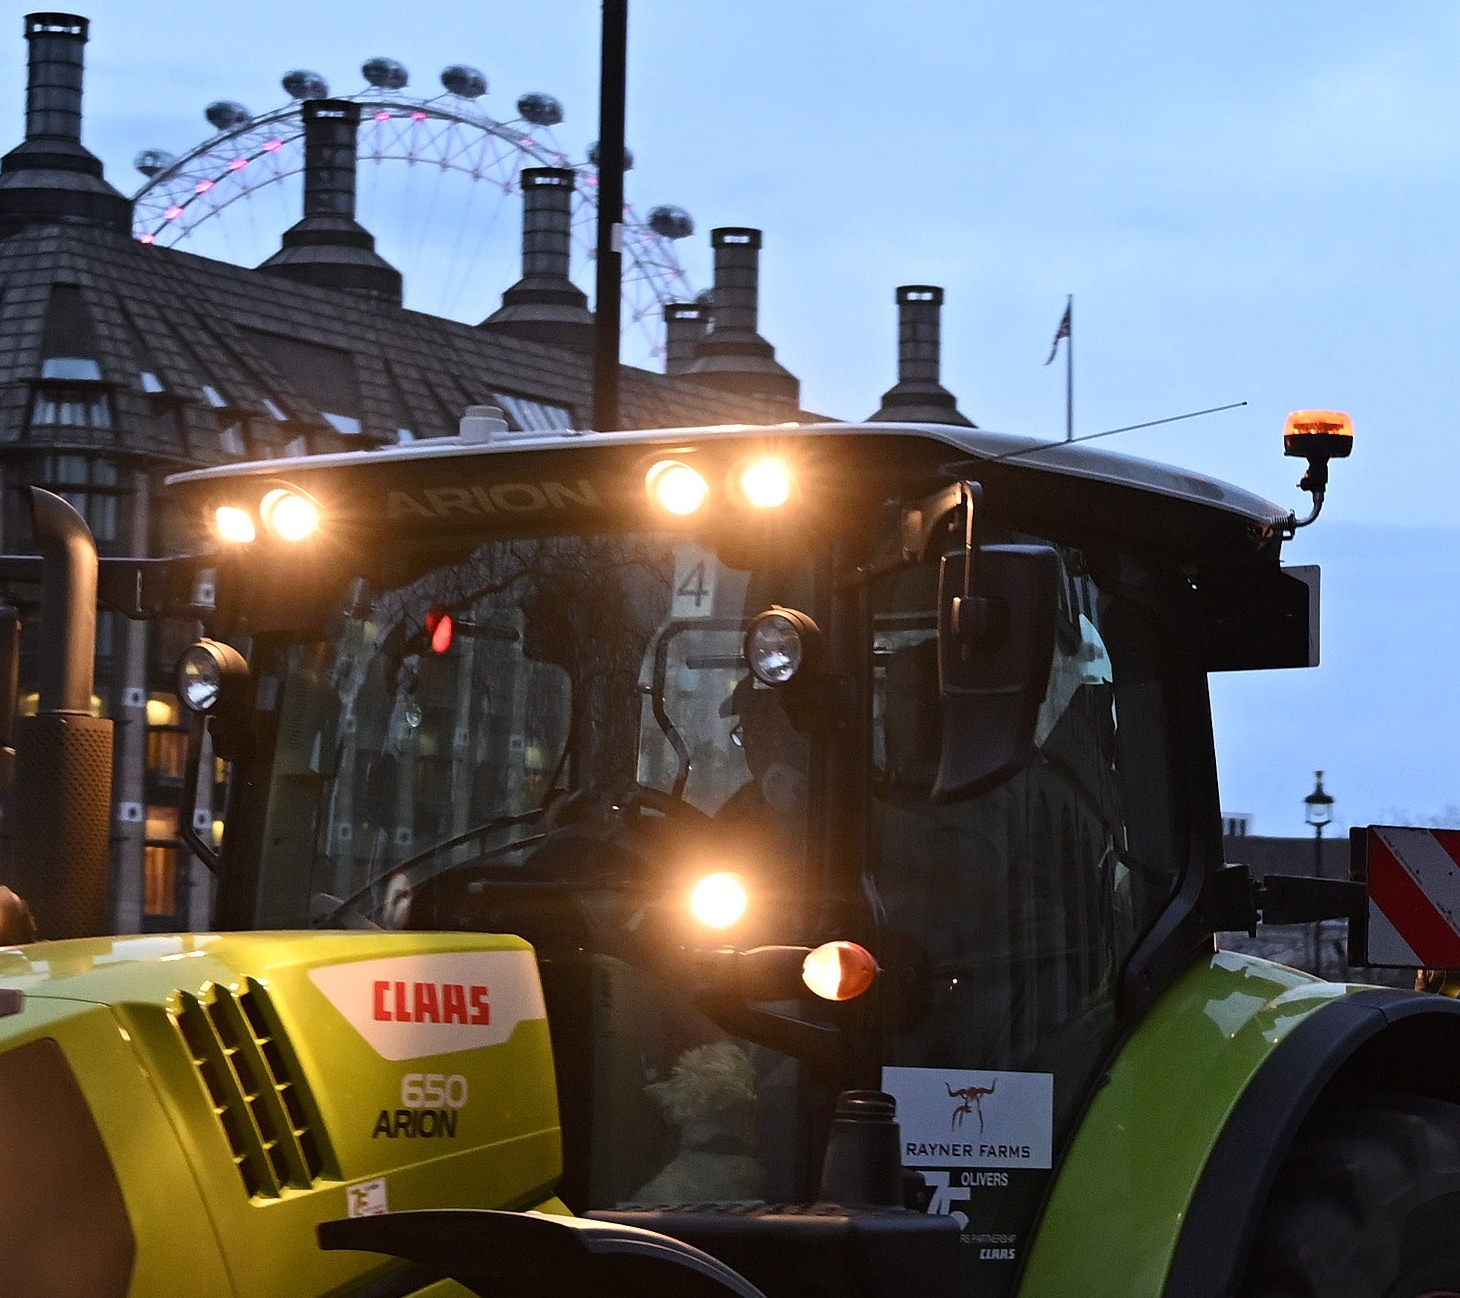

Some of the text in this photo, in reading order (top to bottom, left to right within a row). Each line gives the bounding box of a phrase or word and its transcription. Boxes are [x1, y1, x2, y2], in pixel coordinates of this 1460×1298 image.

[386, 479, 601, 519] ARION
[373, 980, 490, 1026] CLAAS
[401, 1073, 469, 1109] 650
[372, 1110, 457, 1138] ARION
[906, 1142, 1031, 1159] RAYNER FARMS
[960, 1172, 1009, 1188] OLIVERS
[979, 1248, 1016, 1260] CLAAS
